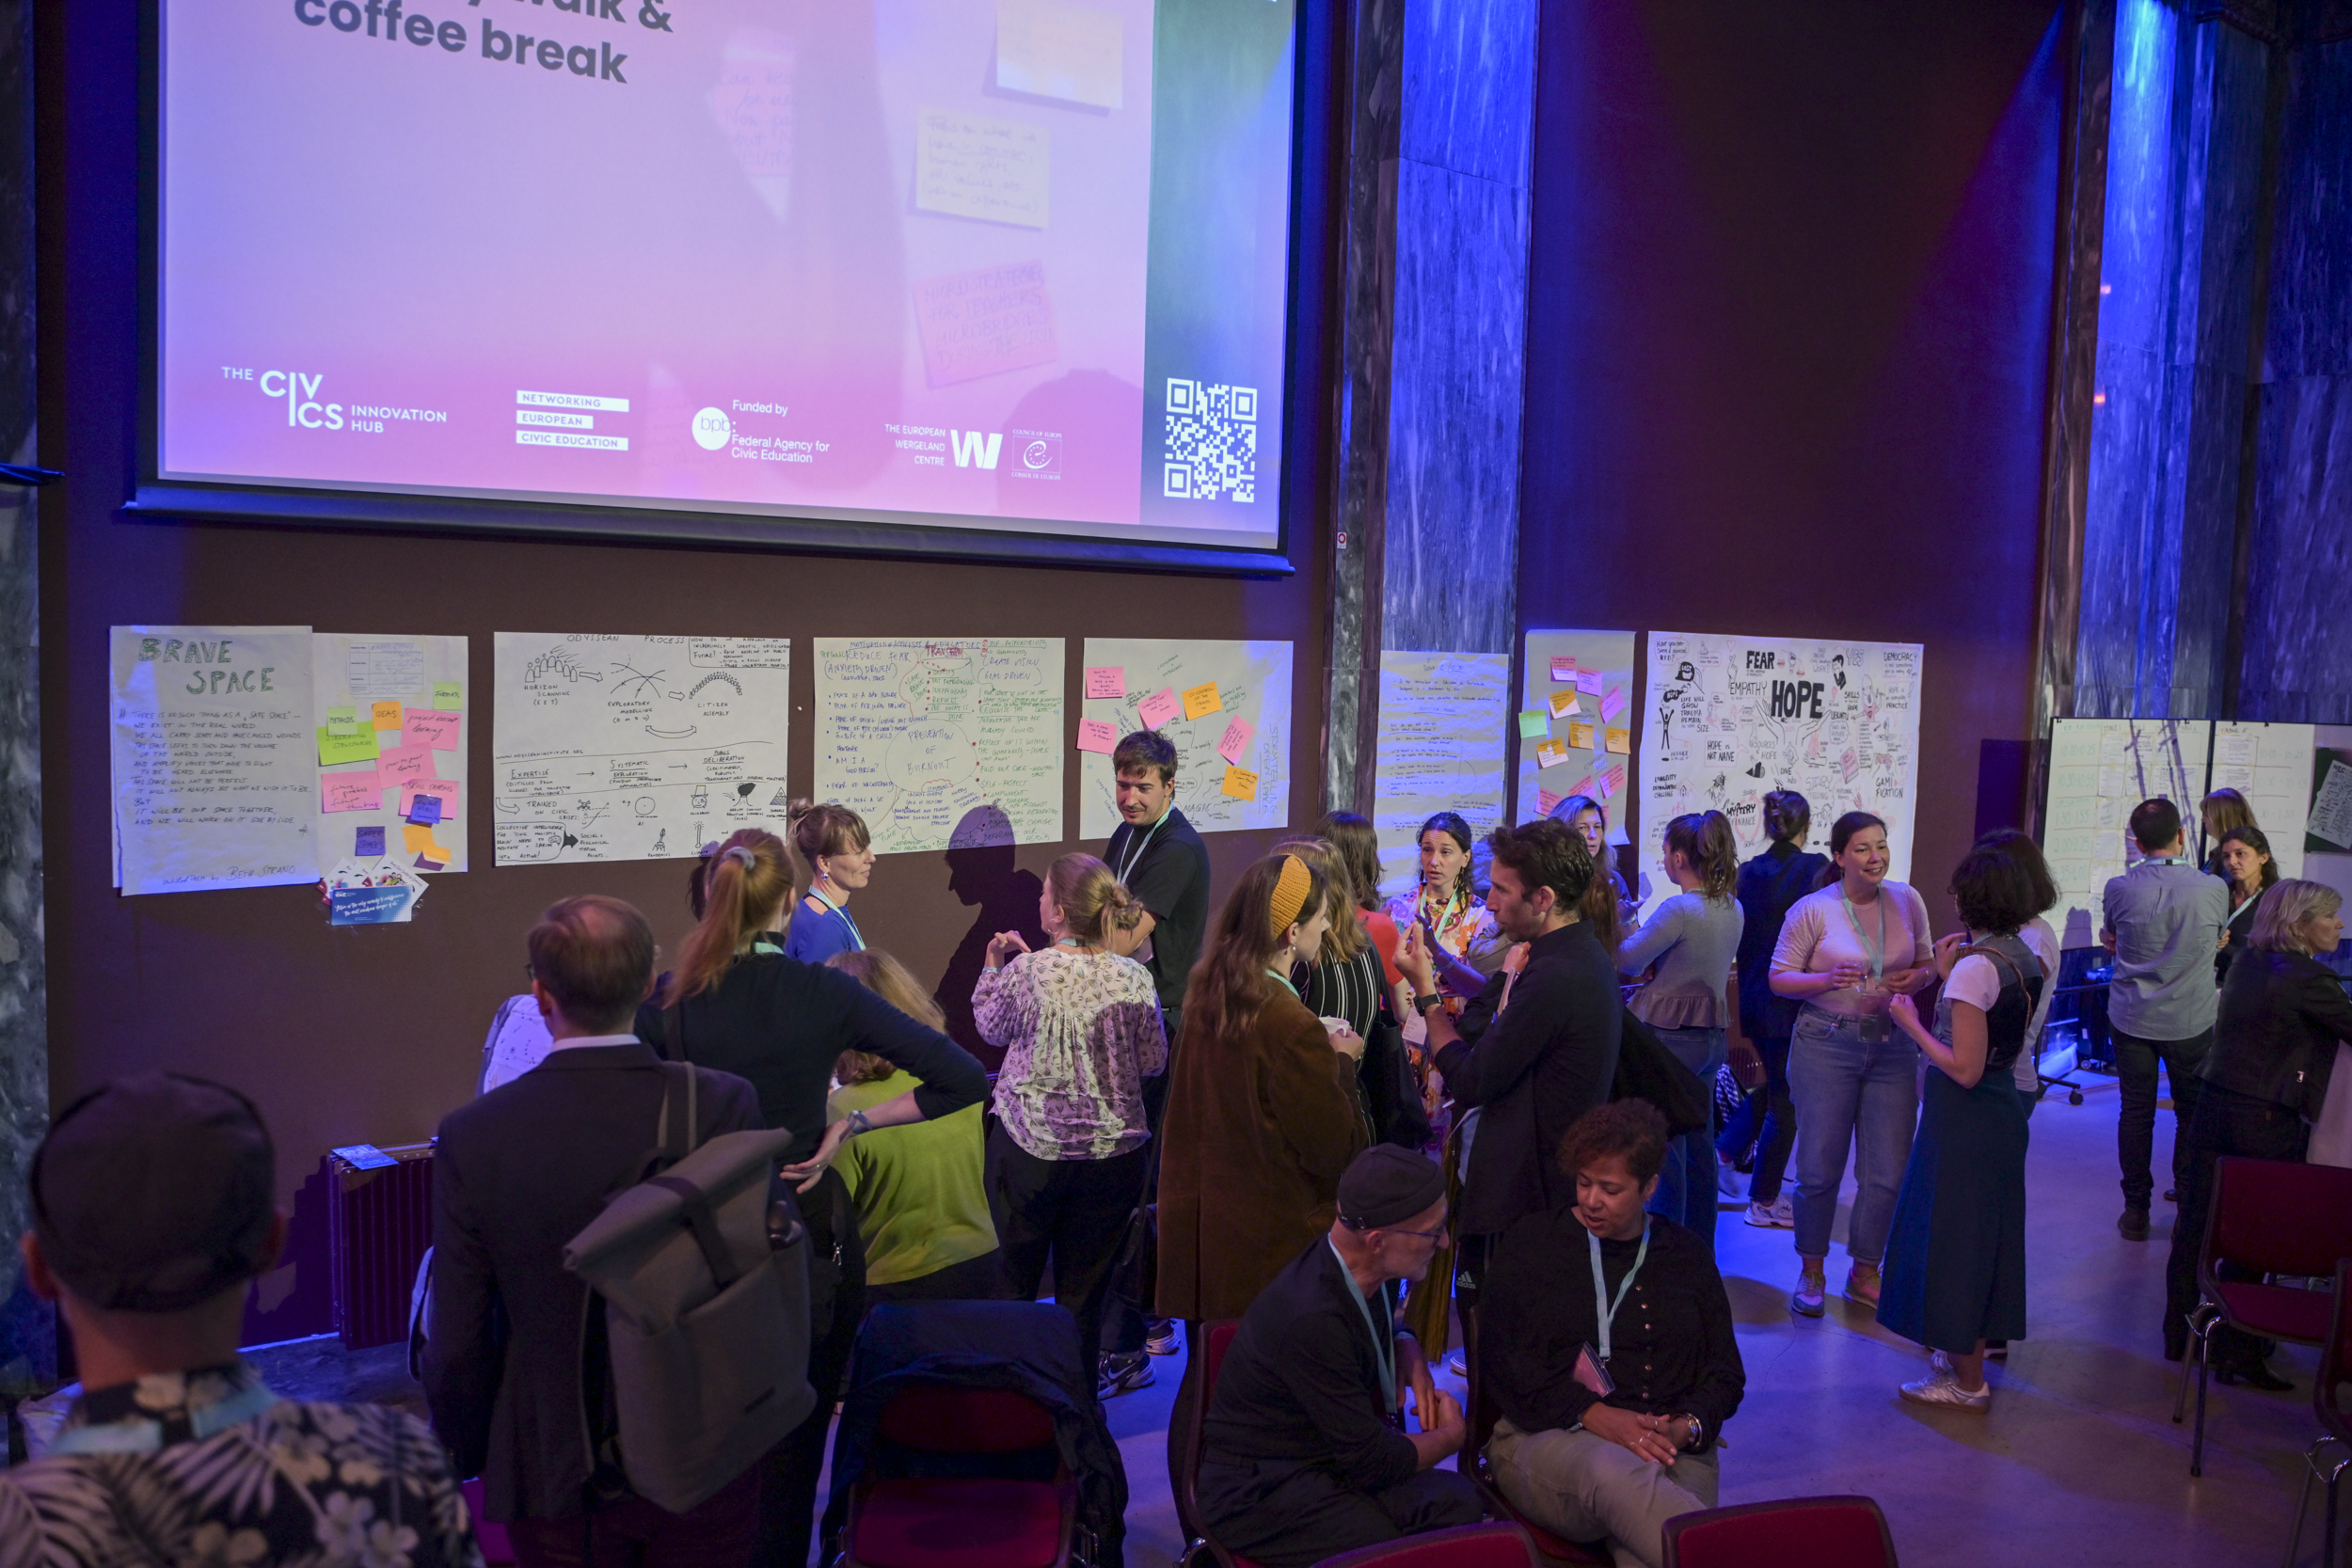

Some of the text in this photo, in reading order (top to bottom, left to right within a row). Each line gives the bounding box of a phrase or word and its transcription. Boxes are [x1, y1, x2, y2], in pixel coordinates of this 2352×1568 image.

[294, 0, 628, 84] coffee break
[221, 367, 253, 380] THE
[523, 393, 601, 407] NETWORKING
[352, 405, 446, 422] INNOVATION
[733, 400, 788, 417] Funded by
[522, 414, 582, 425] EUROPEAN
[352, 420, 384, 433] HUB
[885, 423, 946, 436] THE EUROPEAN
[522, 434, 618, 447] CIVIC EDUCATION
[732, 435, 830, 452] Federal Agency for
[896, 439, 946, 451] WERGELAND
[732, 447, 813, 463] Civic Education
[914, 455, 945, 466] CENTRE
[644, 635, 685, 643] PROCESS
[139, 639, 233, 663] BRAVE
[1846, 648, 1864, 666] YES
[1883, 652, 1917, 662] DEMOCRACY
[1746, 650, 1775, 670] FEAR
[186, 668, 275, 694] SPACE
[1730, 681, 1767, 695] EMPATHY
[1771, 680, 1825, 719] HOPE
[926, 745, 936, 753] OF
[1708, 741, 1722, 751] HOPE
[1708, 752, 1735, 762] NOT NAIVE
[1761, 752, 1777, 760] HOPE
[1876, 777, 1892, 787] GAMI
[1876, 787, 1903, 799] FICATION
[1183, 803, 1211, 813] MAGIC
[226, 866, 254, 880] BETH
[259, 865, 295, 877] STRANO
